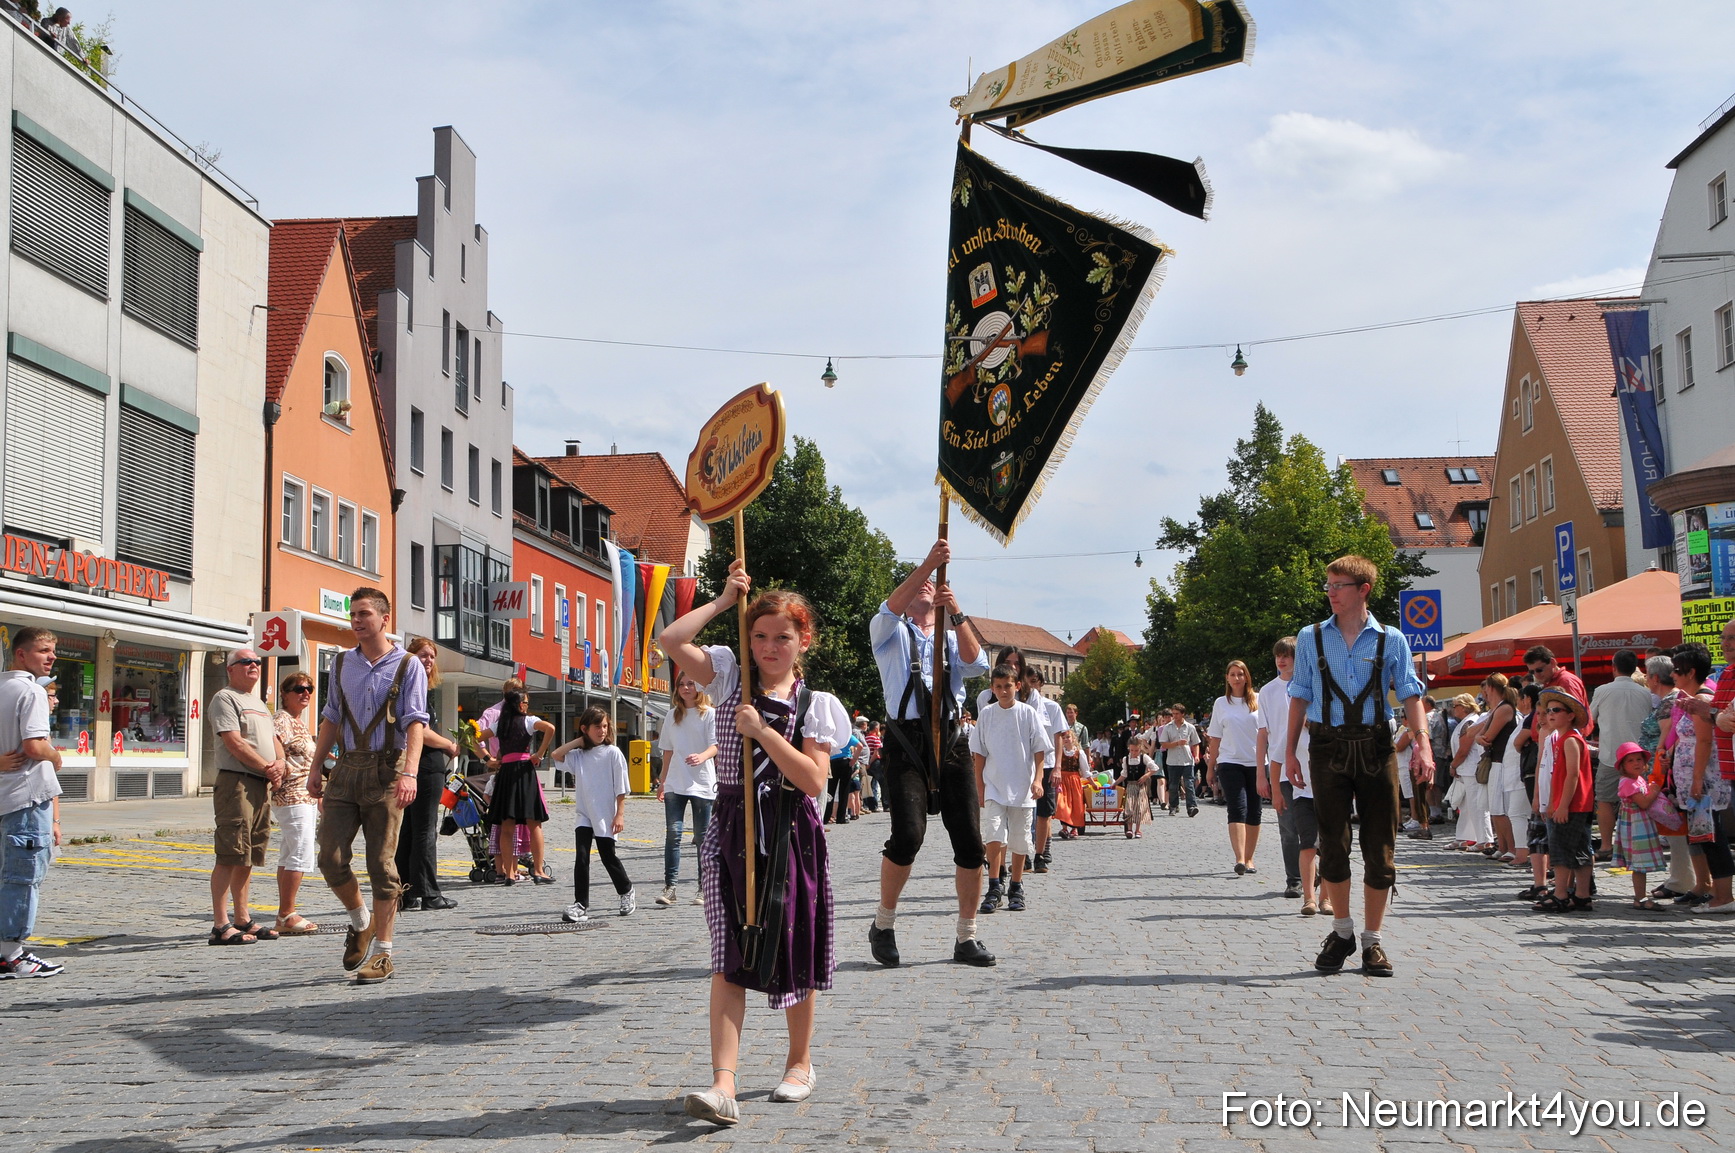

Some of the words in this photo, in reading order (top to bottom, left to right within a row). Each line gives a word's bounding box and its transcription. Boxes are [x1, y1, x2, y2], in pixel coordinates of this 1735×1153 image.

[1093, 31, 1103, 68] Christine
[1110, 20, 1124, 65] Wolfstein
[962, 428, 990, 450] Ziel
[1023, 361, 1063, 414] Leben
[1559, 530, 1570, 569] P
[0, 534, 170, 602] IEN-APOTHEKE
[323, 594, 343, 613] Blumen
[492, 589, 524, 611] H&M
[1694, 602, 1721, 614] Berlin
[1405, 633, 1439, 647] TAXI
[1578, 634, 1658, 655] Glossner-Bier
[585, 644, 590, 665] P
